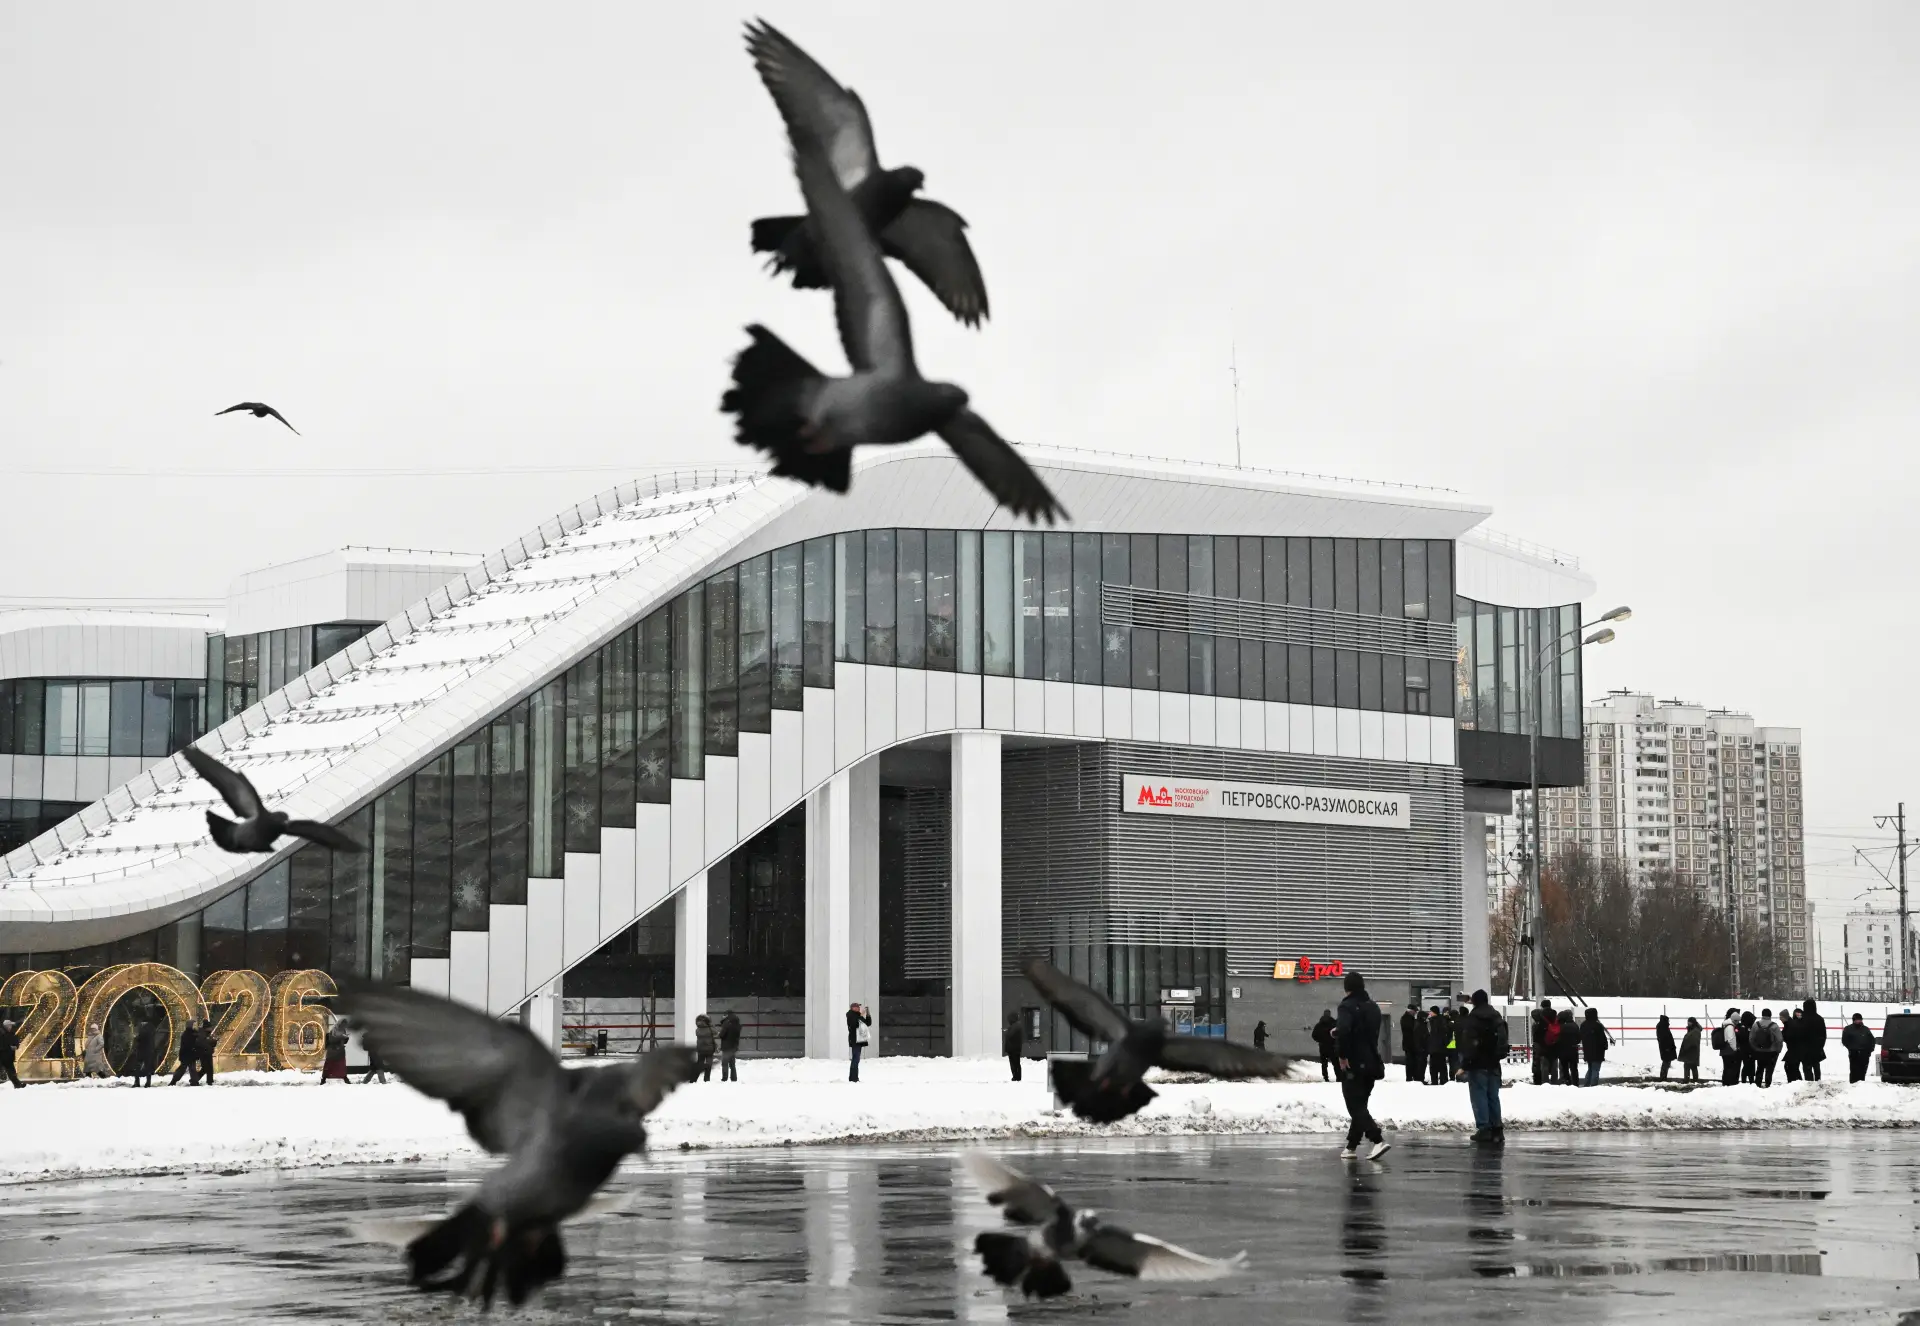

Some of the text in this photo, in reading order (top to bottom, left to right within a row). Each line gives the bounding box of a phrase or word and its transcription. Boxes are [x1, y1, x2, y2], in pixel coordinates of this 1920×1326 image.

[1175, 787, 1209, 795] МОСКОВСКИЙ
[1222, 790, 1398, 816] ПЕТРОВСКО-РАЗУМОВСКАЯ
[1279, 964, 1290, 976] D1
[0, 962, 338, 1080] 2026
